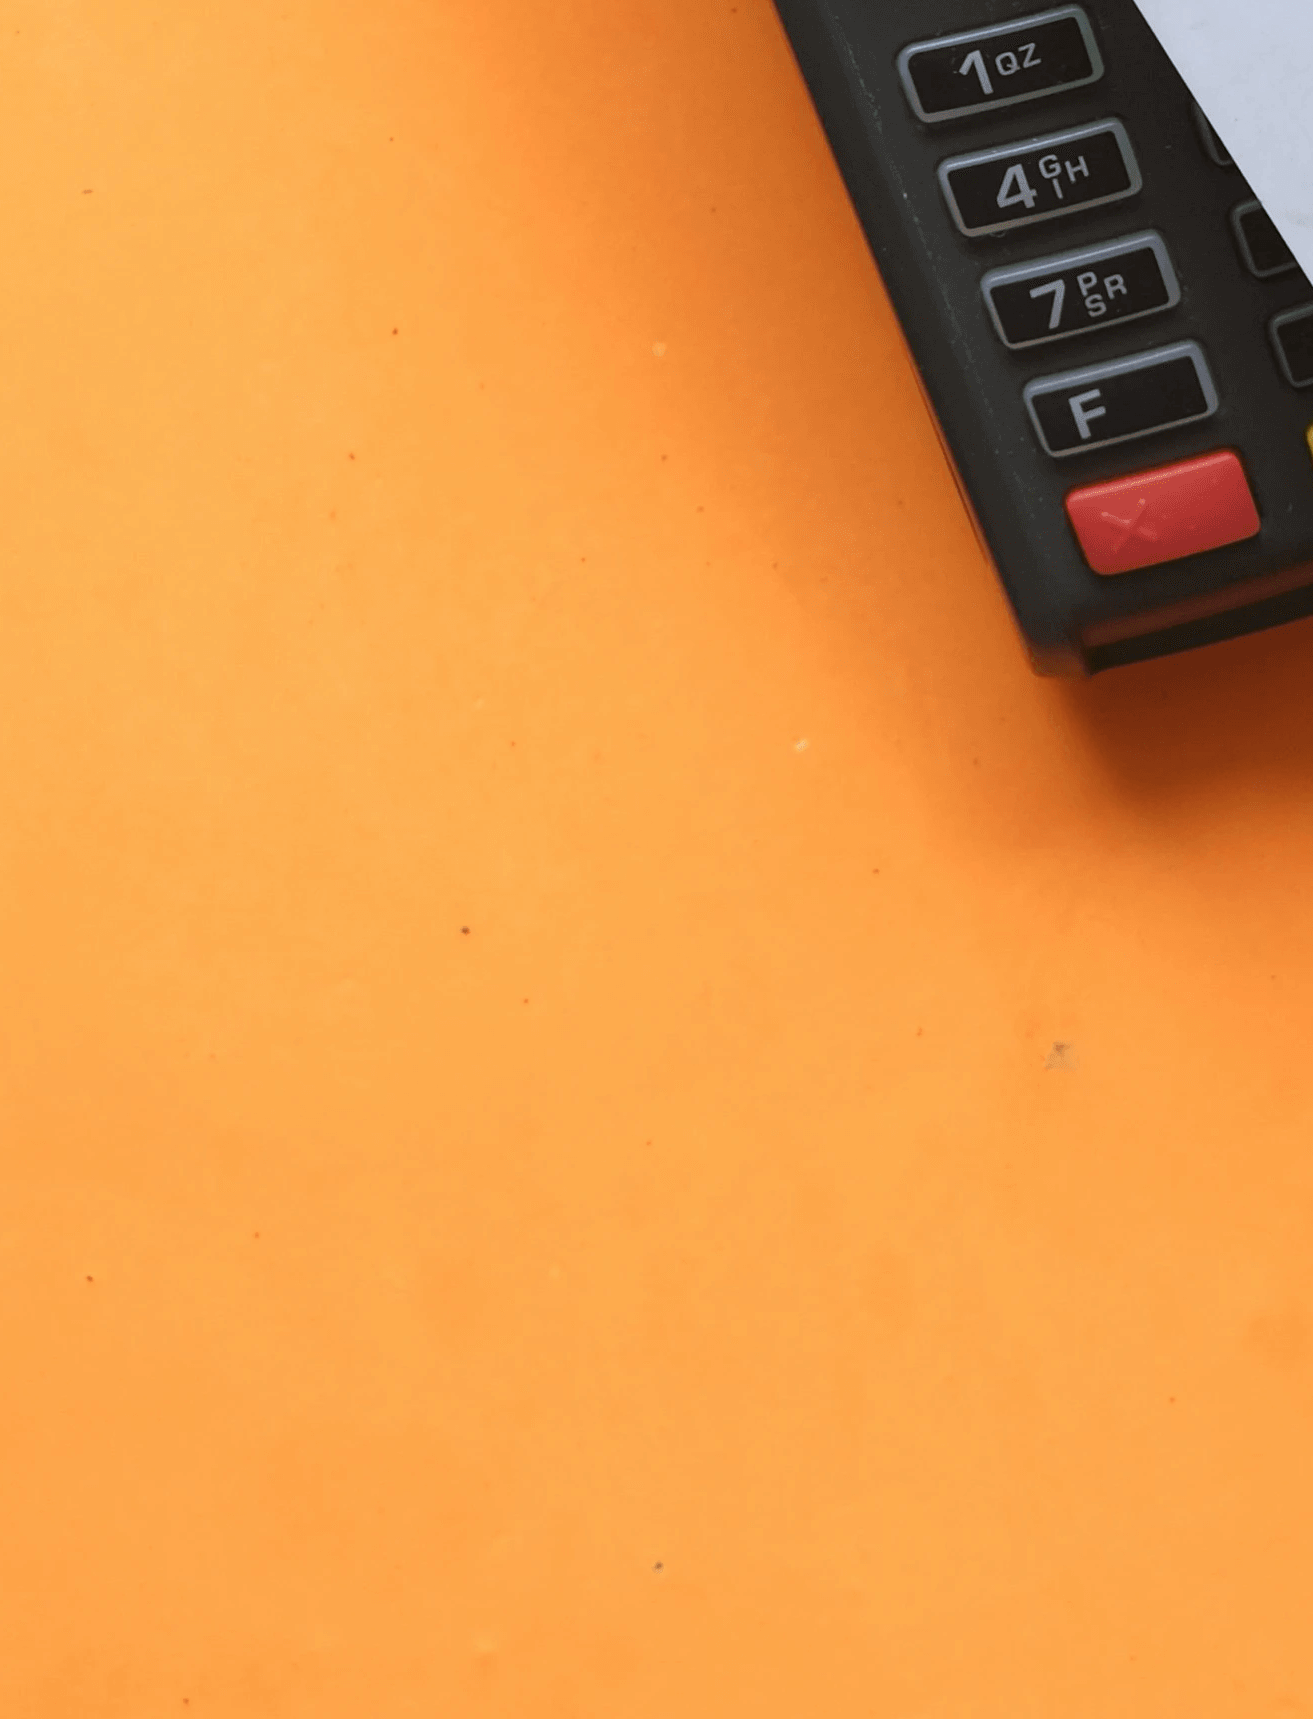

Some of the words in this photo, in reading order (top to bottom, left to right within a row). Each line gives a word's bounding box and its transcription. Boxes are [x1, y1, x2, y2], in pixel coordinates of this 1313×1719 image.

[996, 163, 1038, 209] 4
[1029, 279, 1066, 330] 7
[1068, 388, 1107, 440] F
